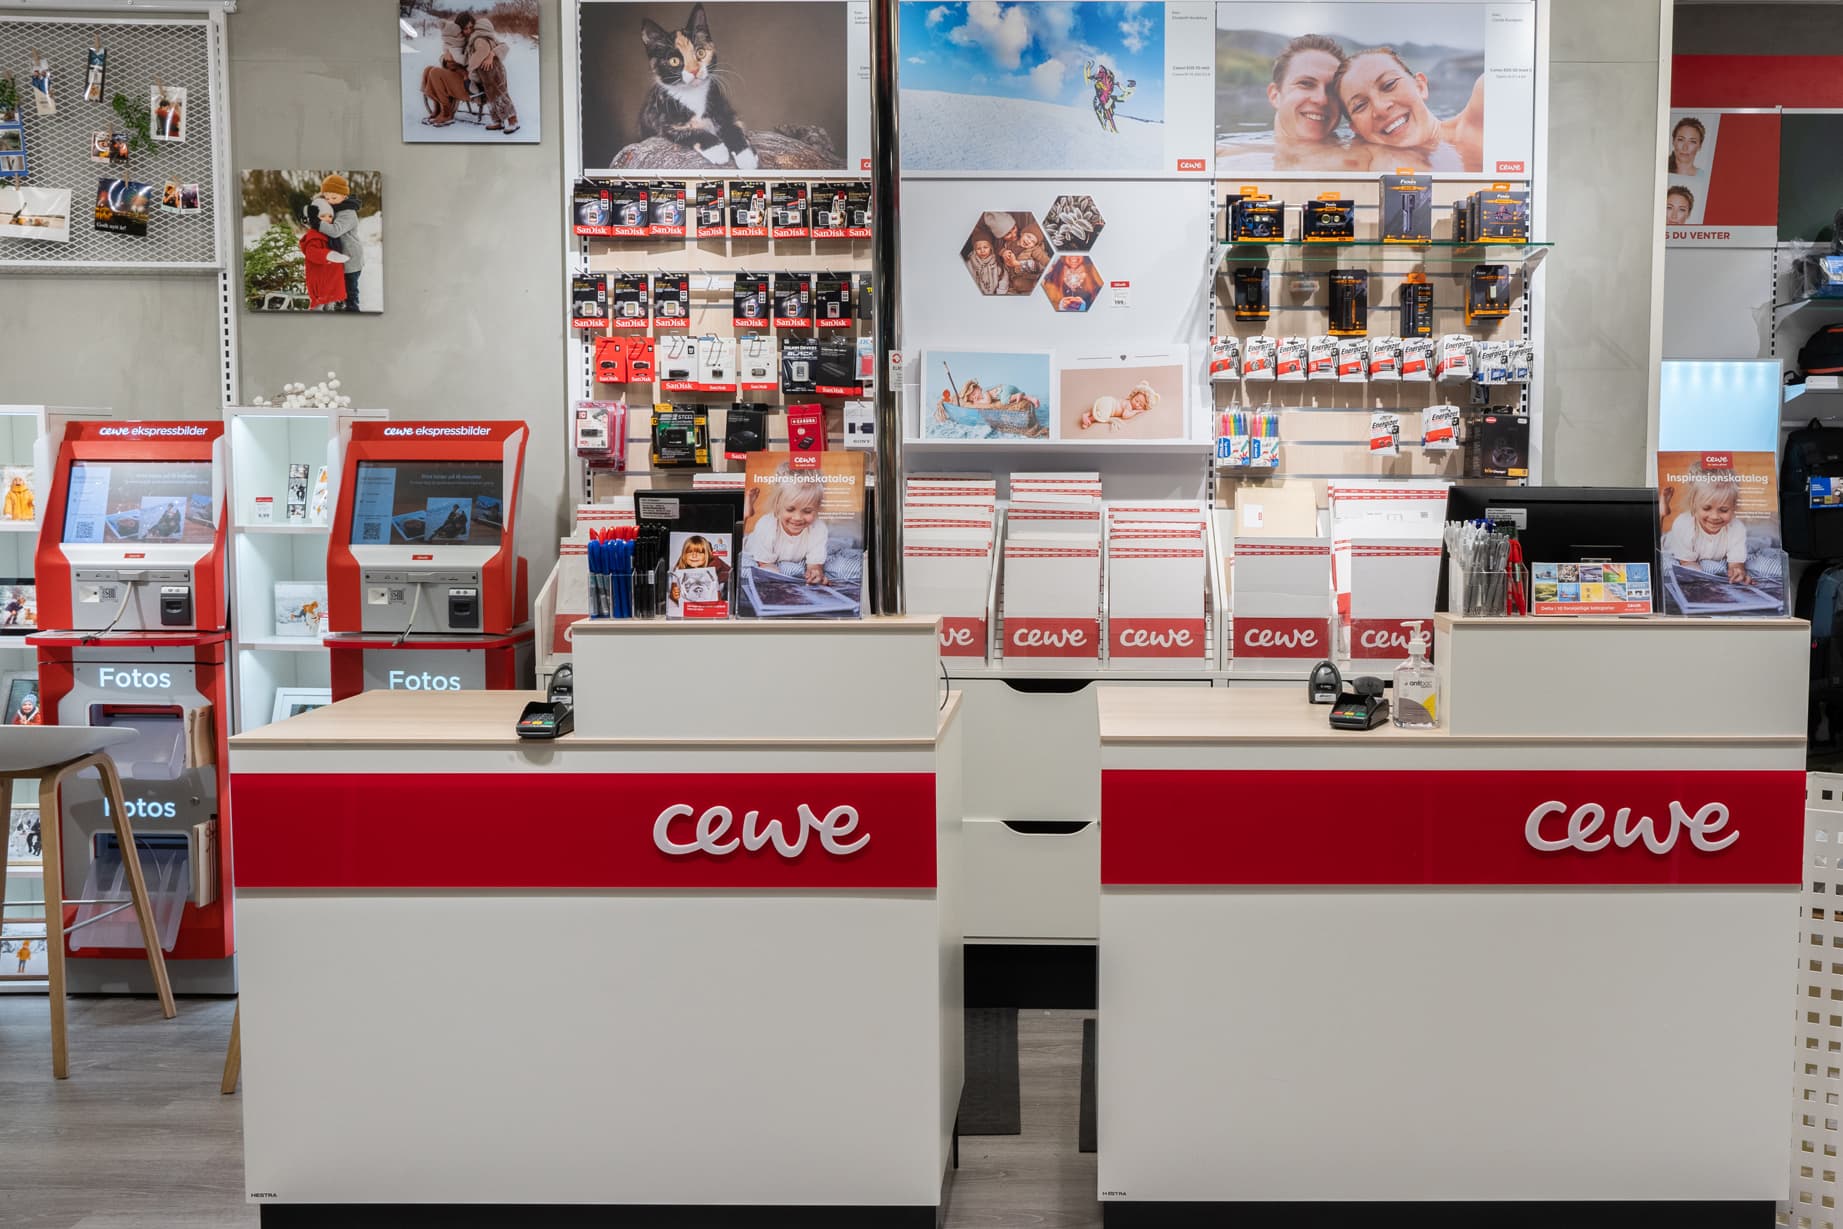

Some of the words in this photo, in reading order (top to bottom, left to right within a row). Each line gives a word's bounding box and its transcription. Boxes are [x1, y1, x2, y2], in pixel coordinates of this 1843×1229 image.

[577, 226, 607, 234] SanDisk
[652, 226, 682, 234] SanDisk
[698, 229, 724, 237] SanDisk
[733, 228, 764, 236] SanDisk
[774, 229, 805, 237] SanDisk
[574, 319, 604, 327] SanDisk
[656, 319, 686, 327] SanDisk
[735, 319, 766, 327] SanDisk
[776, 318, 806, 326] SanDisk
[1213, 342, 1237, 353] Energizer
[1248, 342, 1274, 353] Energizer
[1279, 343, 1305, 353] Energizer
[1311, 342, 1338, 352] Energizer
[1341, 344, 1368, 356] Energizer
[1374, 342, 1401, 354] Energizer
[1405, 342, 1432, 353] Energizer
[1445, 340, 1471, 350] Energizer
[1482, 349, 1508, 361] Energizer
[1432, 410, 1459, 421] Energizer
[1372, 419, 1398, 429] Energizer
[99, 426, 130, 436] cewe
[131, 426, 208, 437] ekspressbilder
[384, 426, 414, 436] cewe
[415, 426, 491, 437] ekspressbilder
[754, 474, 855, 485] Inspirasjonskatalog
[1667, 473, 1769, 484] Inspirasjonskatalog
[940, 628, 975, 647] we
[1013, 628, 1087, 648] cewe
[1119, 628, 1193, 649] cewe
[1244, 628, 1319, 649] cewe
[99, 667, 171, 688] Fotos
[389, 670, 461, 690] Fotos
[653, 803, 871, 858] cewe
[1525, 800, 1740, 855] cewe
